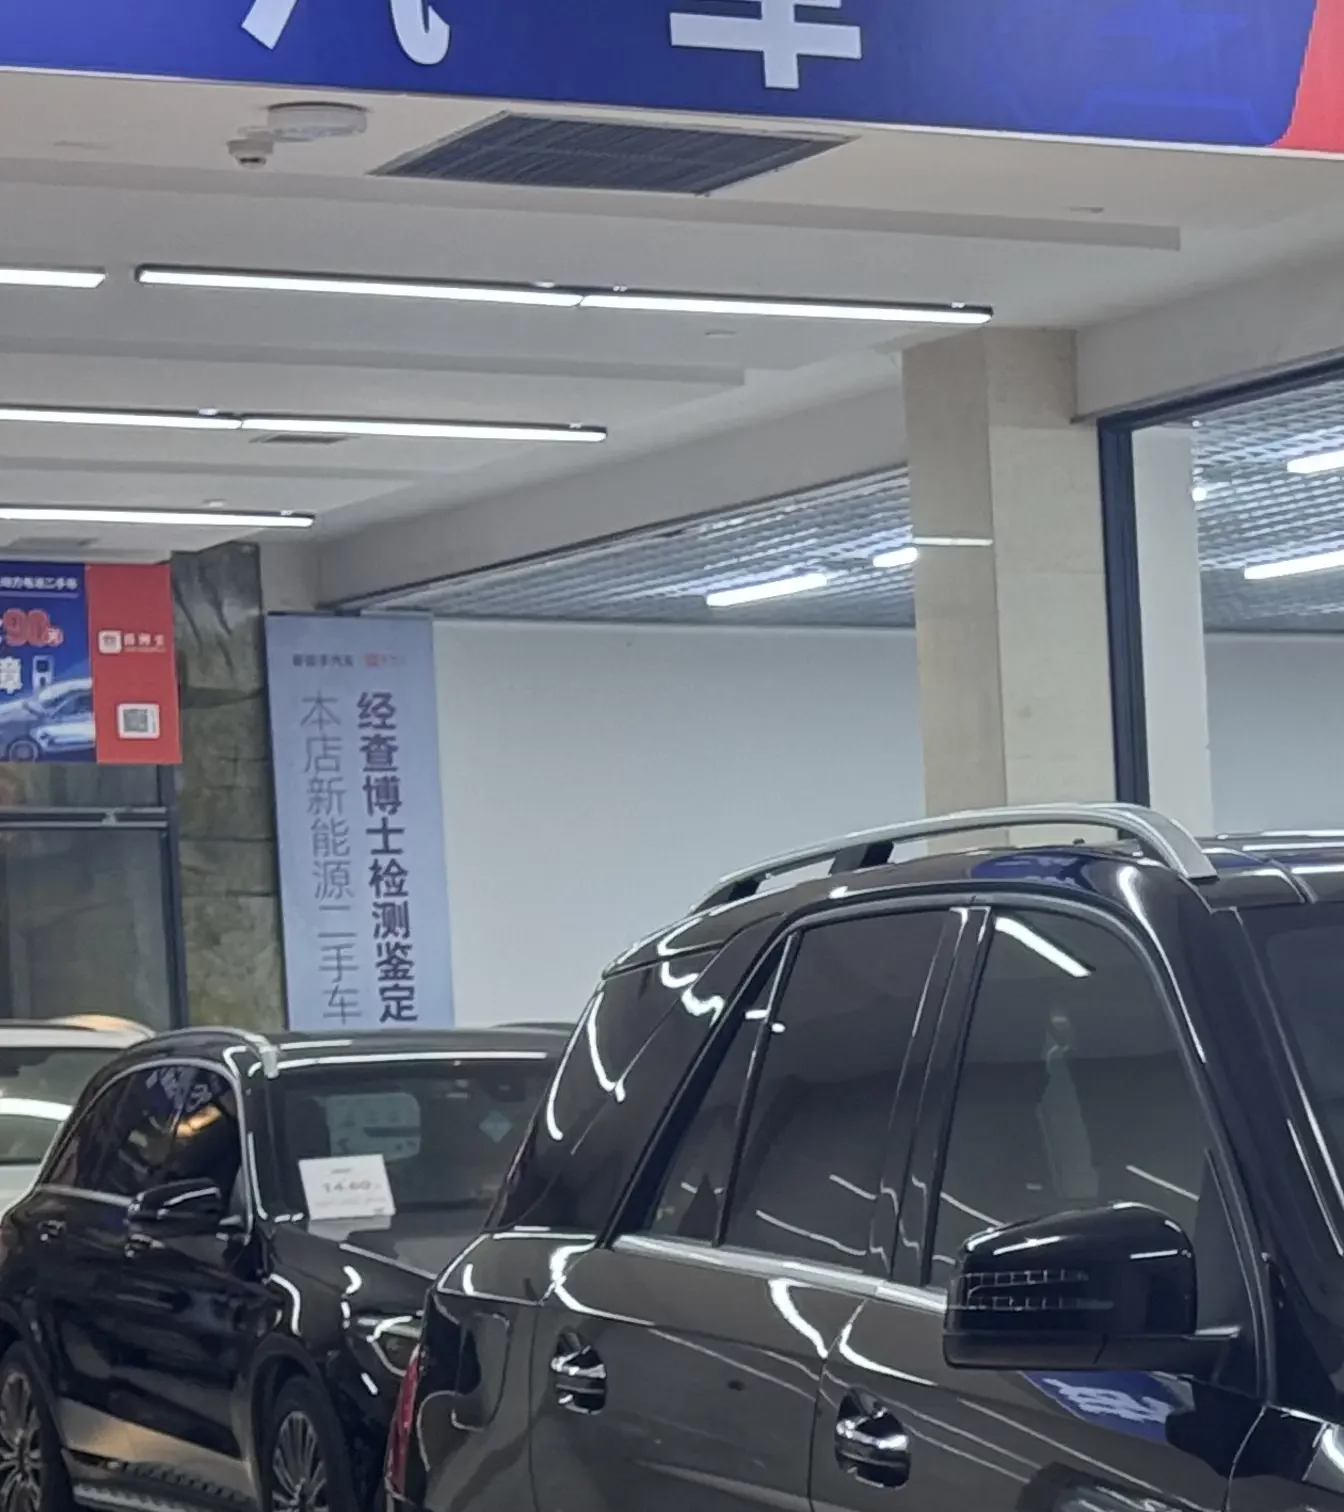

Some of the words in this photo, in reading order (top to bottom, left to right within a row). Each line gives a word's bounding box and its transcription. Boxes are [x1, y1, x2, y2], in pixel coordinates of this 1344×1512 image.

[300, 689, 363, 1025] 本店新能源二手车
[356, 691, 418, 1023] 经查博士检测鉴定
